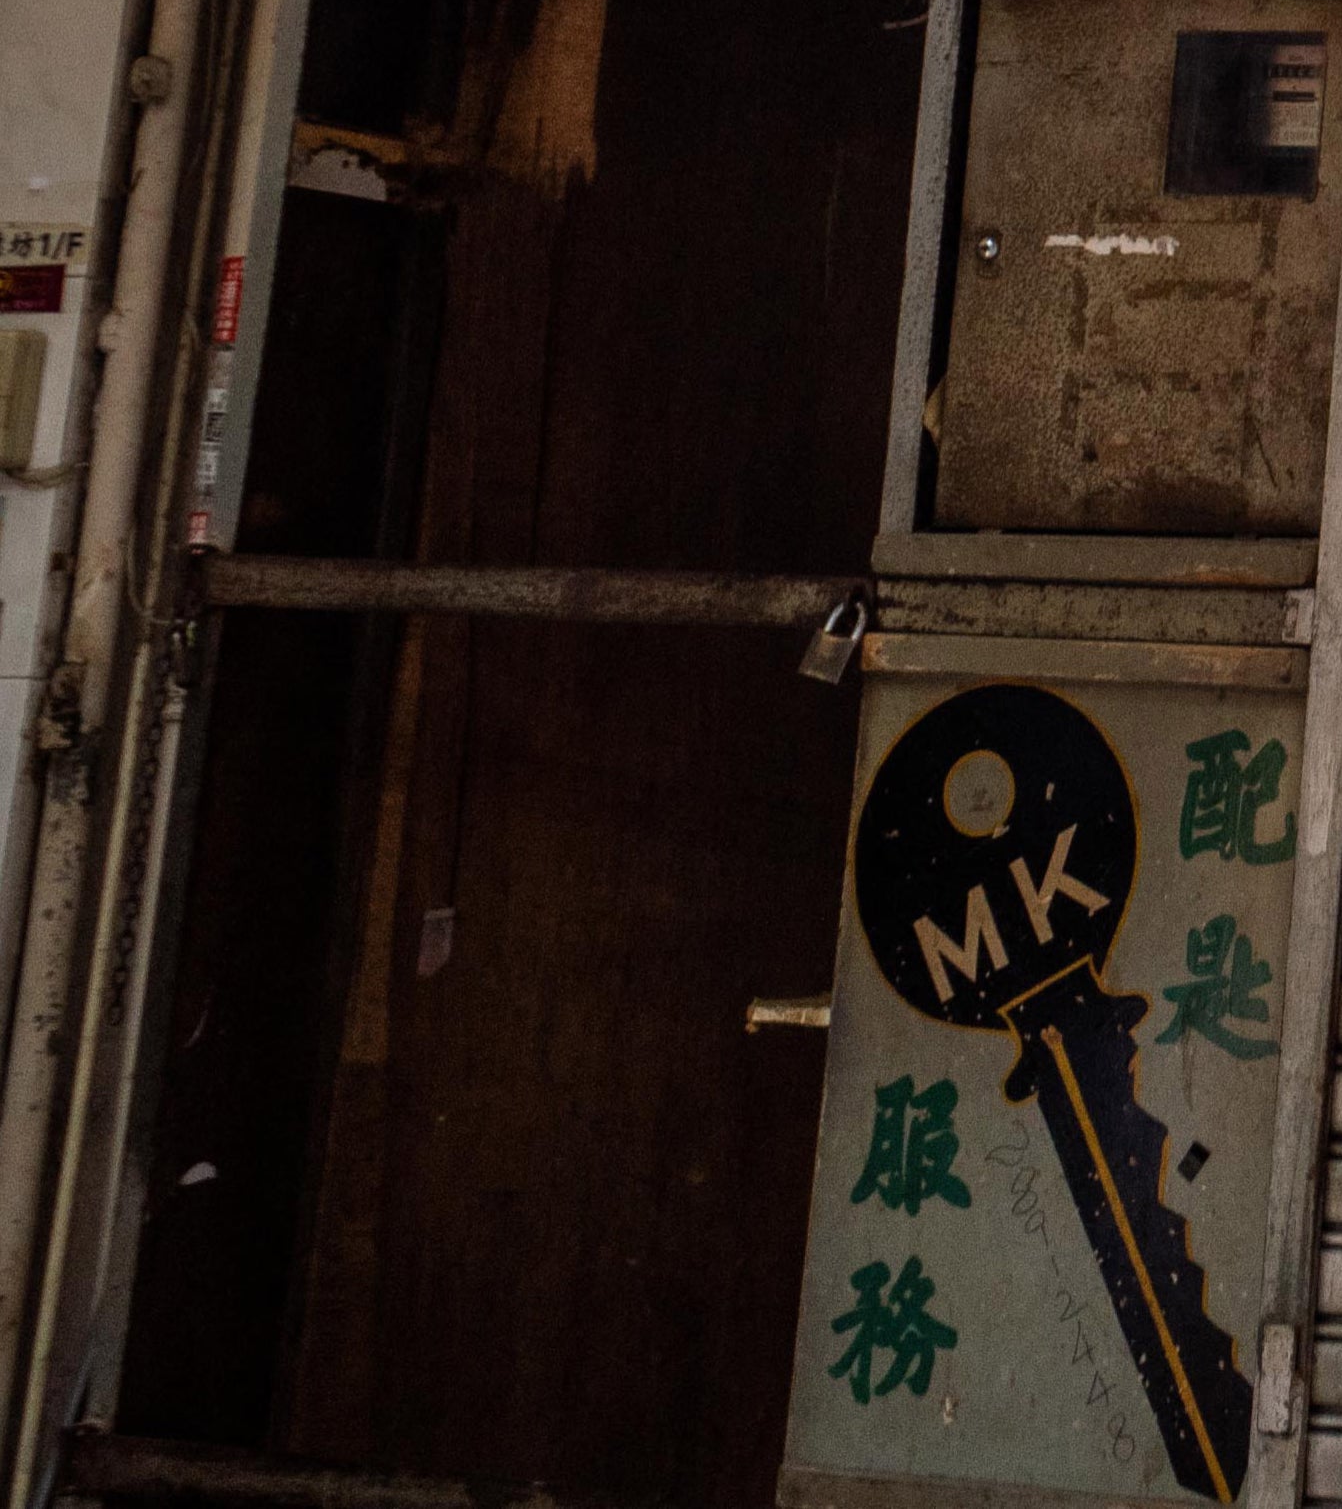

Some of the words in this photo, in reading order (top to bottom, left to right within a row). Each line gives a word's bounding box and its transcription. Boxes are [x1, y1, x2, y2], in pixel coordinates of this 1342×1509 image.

[911, 821, 1112, 1004] MK
[1155, 727, 1298, 1061] 配匙
[828, 1074, 973, 1406] 服務
